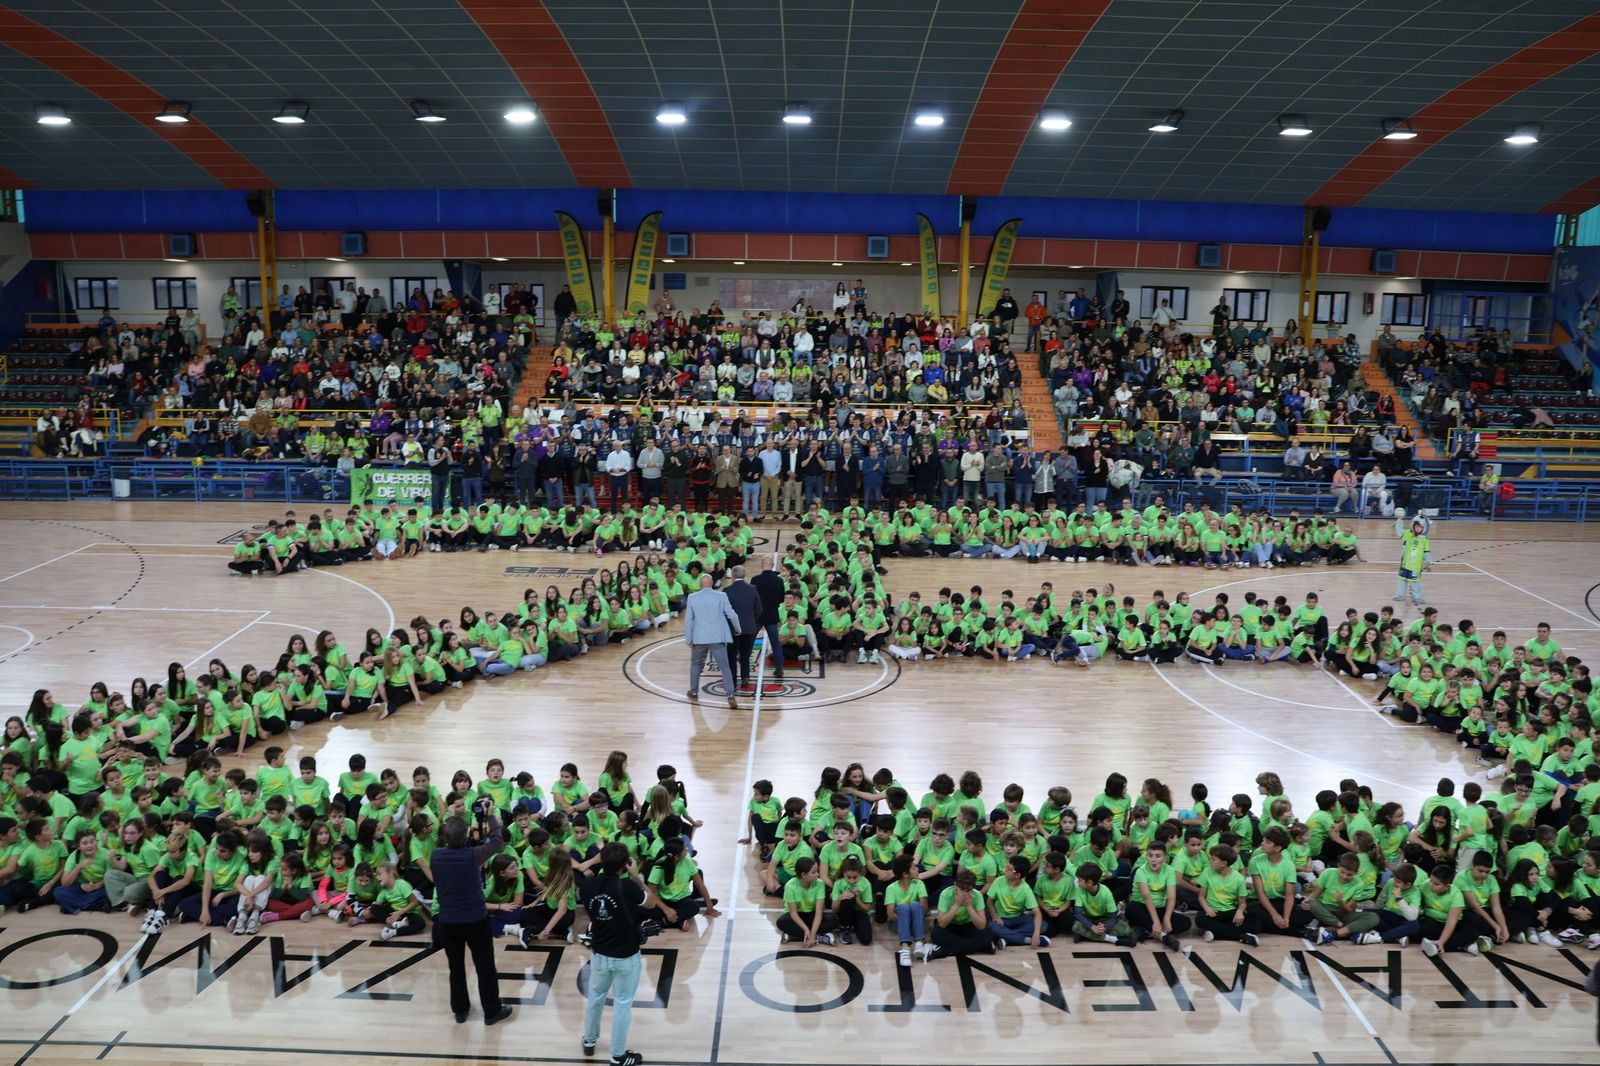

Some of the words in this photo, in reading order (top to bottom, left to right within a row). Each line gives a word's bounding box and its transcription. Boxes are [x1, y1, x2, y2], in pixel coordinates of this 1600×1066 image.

[372, 472, 432, 485] GUERRER
[377, 486, 396, 499] DE
[0, 928, 446, 1002] ZAMO
